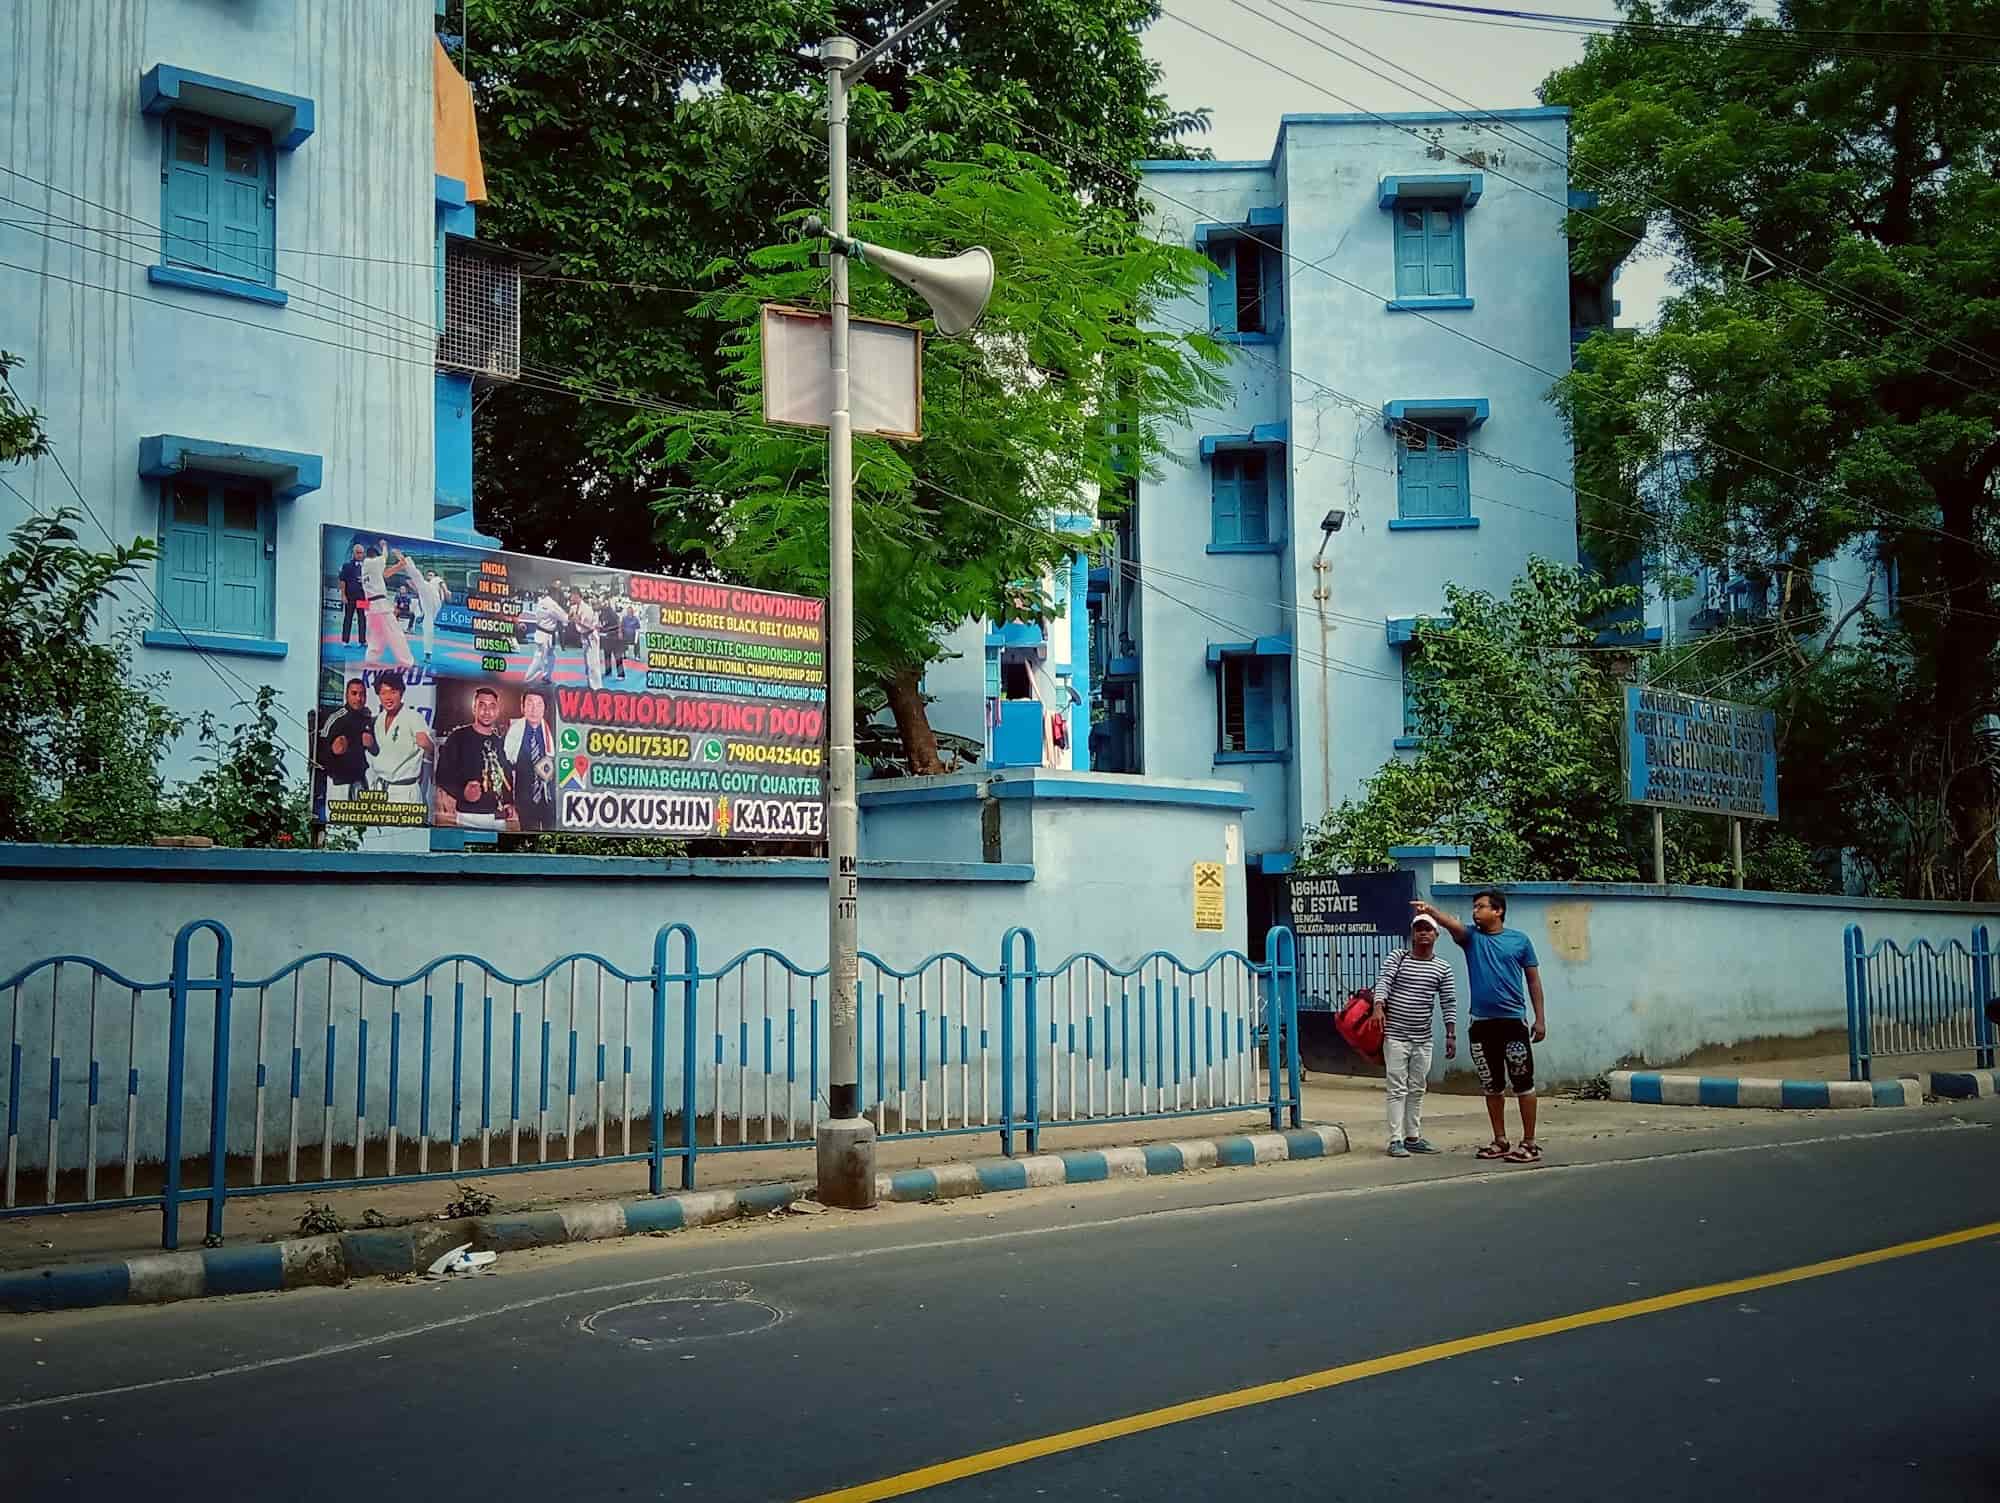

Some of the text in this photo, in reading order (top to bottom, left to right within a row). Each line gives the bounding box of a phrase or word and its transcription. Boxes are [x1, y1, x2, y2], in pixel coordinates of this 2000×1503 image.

[481, 561, 508, 577] INDIA
[480, 581, 509, 595] IN 6TH
[468, 598, 521, 615] WORLD CUP
[630, 576, 824, 621] SENSEI SUMIT CHOWDHURY
[473, 618, 514, 633] MOSCOW
[661, 609, 682, 624] 2ND
[686, 613, 726, 629] DEGREE
[727, 618, 758, 633] BLACK
[760, 622, 783, 636] BELT
[475, 637, 510, 652] RUSSIA
[646, 633, 822, 665] 1ST PLACE IN STATE CHAMPIONSHIP 2011
[483, 658, 505, 671] 2019
[650, 653, 823, 682] 2ND PLACE IN NATIONAL CHAMPIONSHIP 2017
[648, 674, 664, 687] 2ND
[666, 676, 688, 690] PLACE
[690, 678, 699, 691] IN
[700, 679, 756, 696] INTERNATIONAL
[757, 684, 808, 700] CHAMPIONSHIP
[559, 690, 822, 737] WARRIOR INSTINCT DOJO
[588, 733, 689, 758] 8961175312
[727, 743, 821, 767] 7980425405
[592, 765, 820, 796] BAISHNABGHATA GOVT QUARTER
[359, 791, 387, 800] WITH
[329, 801, 427, 814] WORLD CHAMPION
[564, 792, 713, 830] KYOKUSHIN
[734, 800, 823, 834] KARATE
[400, 815, 423, 825] SHO
[1311, 896, 1358, 913] ESTATE
[1294, 914, 1324, 924] BENGAL
